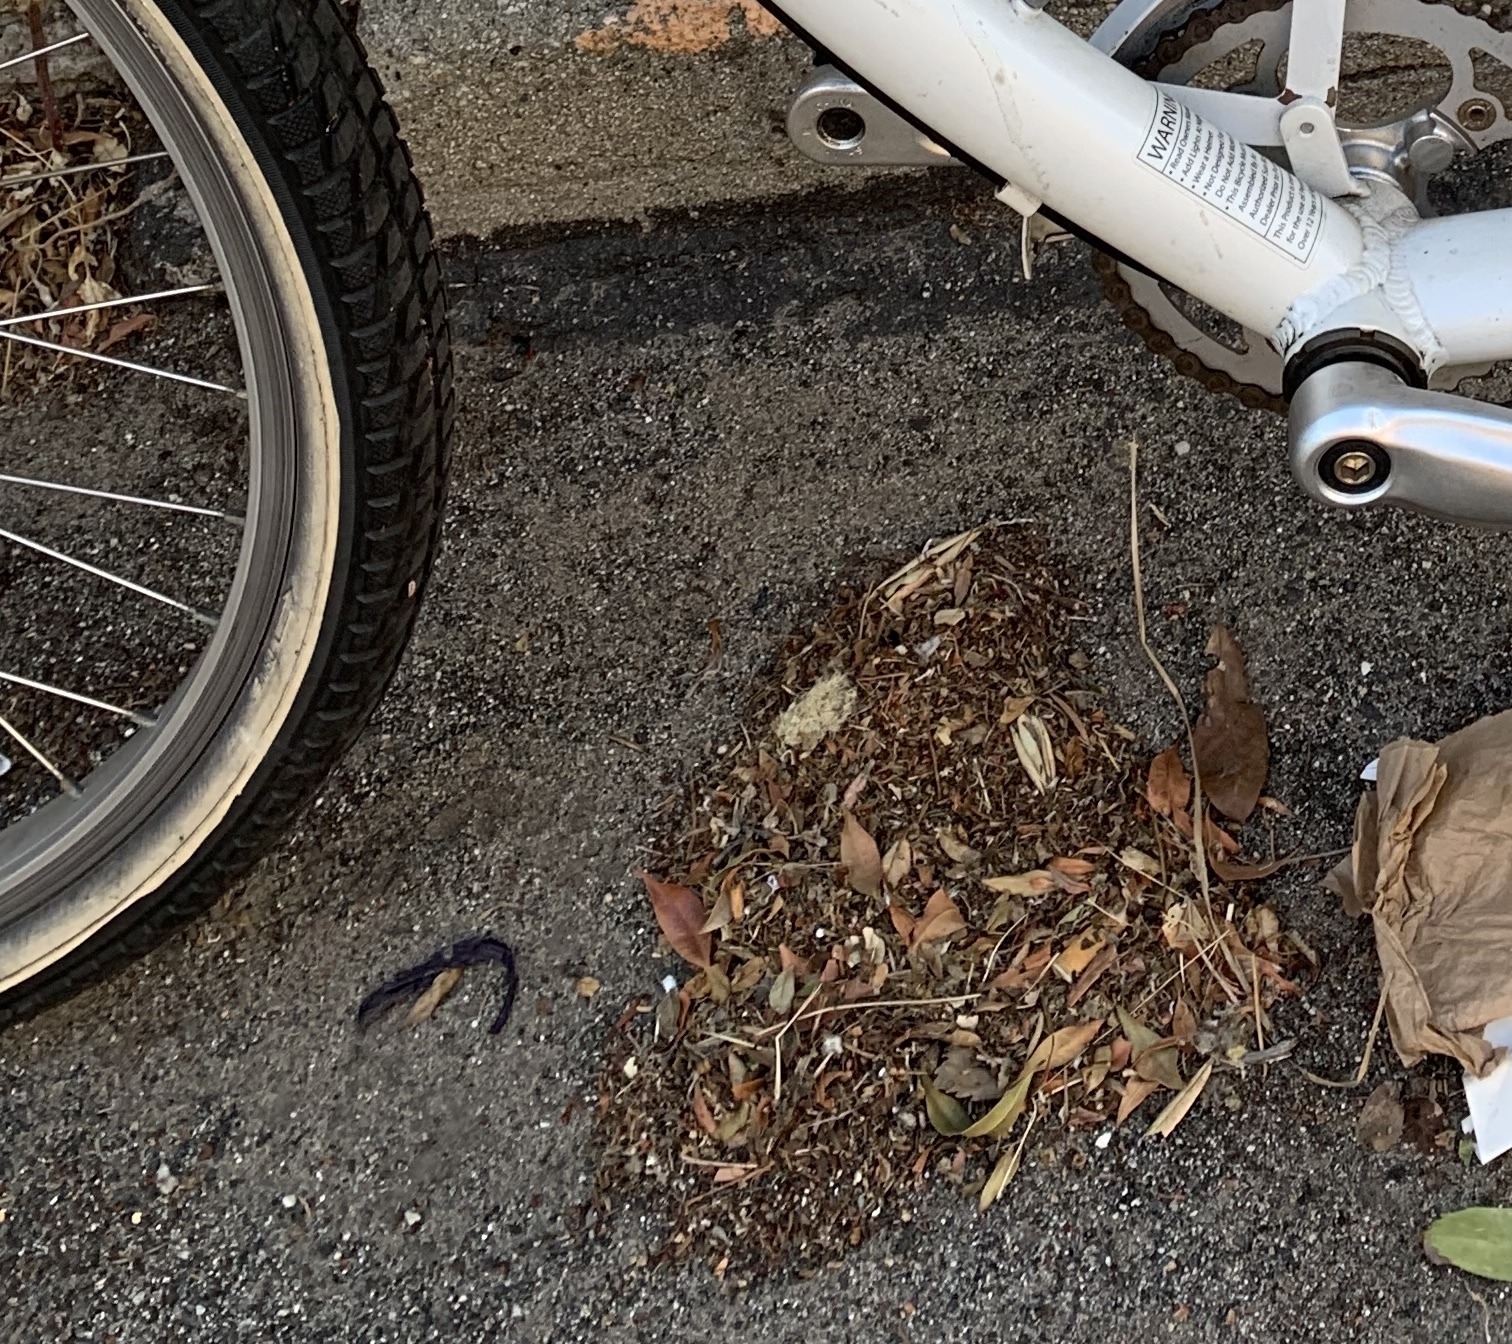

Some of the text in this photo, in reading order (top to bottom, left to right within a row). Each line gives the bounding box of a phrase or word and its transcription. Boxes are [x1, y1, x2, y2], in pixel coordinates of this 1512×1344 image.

[1147, 93, 1178, 160] WARNIN
[1170, 146, 1184, 169] Read
[1182, 157, 1194, 177] Add
[1192, 161, 1206, 183] Wear
[1204, 174, 1216, 191] Not
[1215, 184, 1226, 198] Do
[1221, 168, 1232, 184] Not
[1226, 187, 1239, 204] This
[1238, 167, 1257, 213] Assembled
[1249, 174, 1268, 220] Authorized
[1260, 198, 1275, 226] Dealer
[1273, 222, 1286, 239] This
[1286, 230, 1296, 244] for
[1293, 216, 1301, 230] the
[1297, 229, 1311, 250] Over
[1306, 217, 1314, 228] 12
